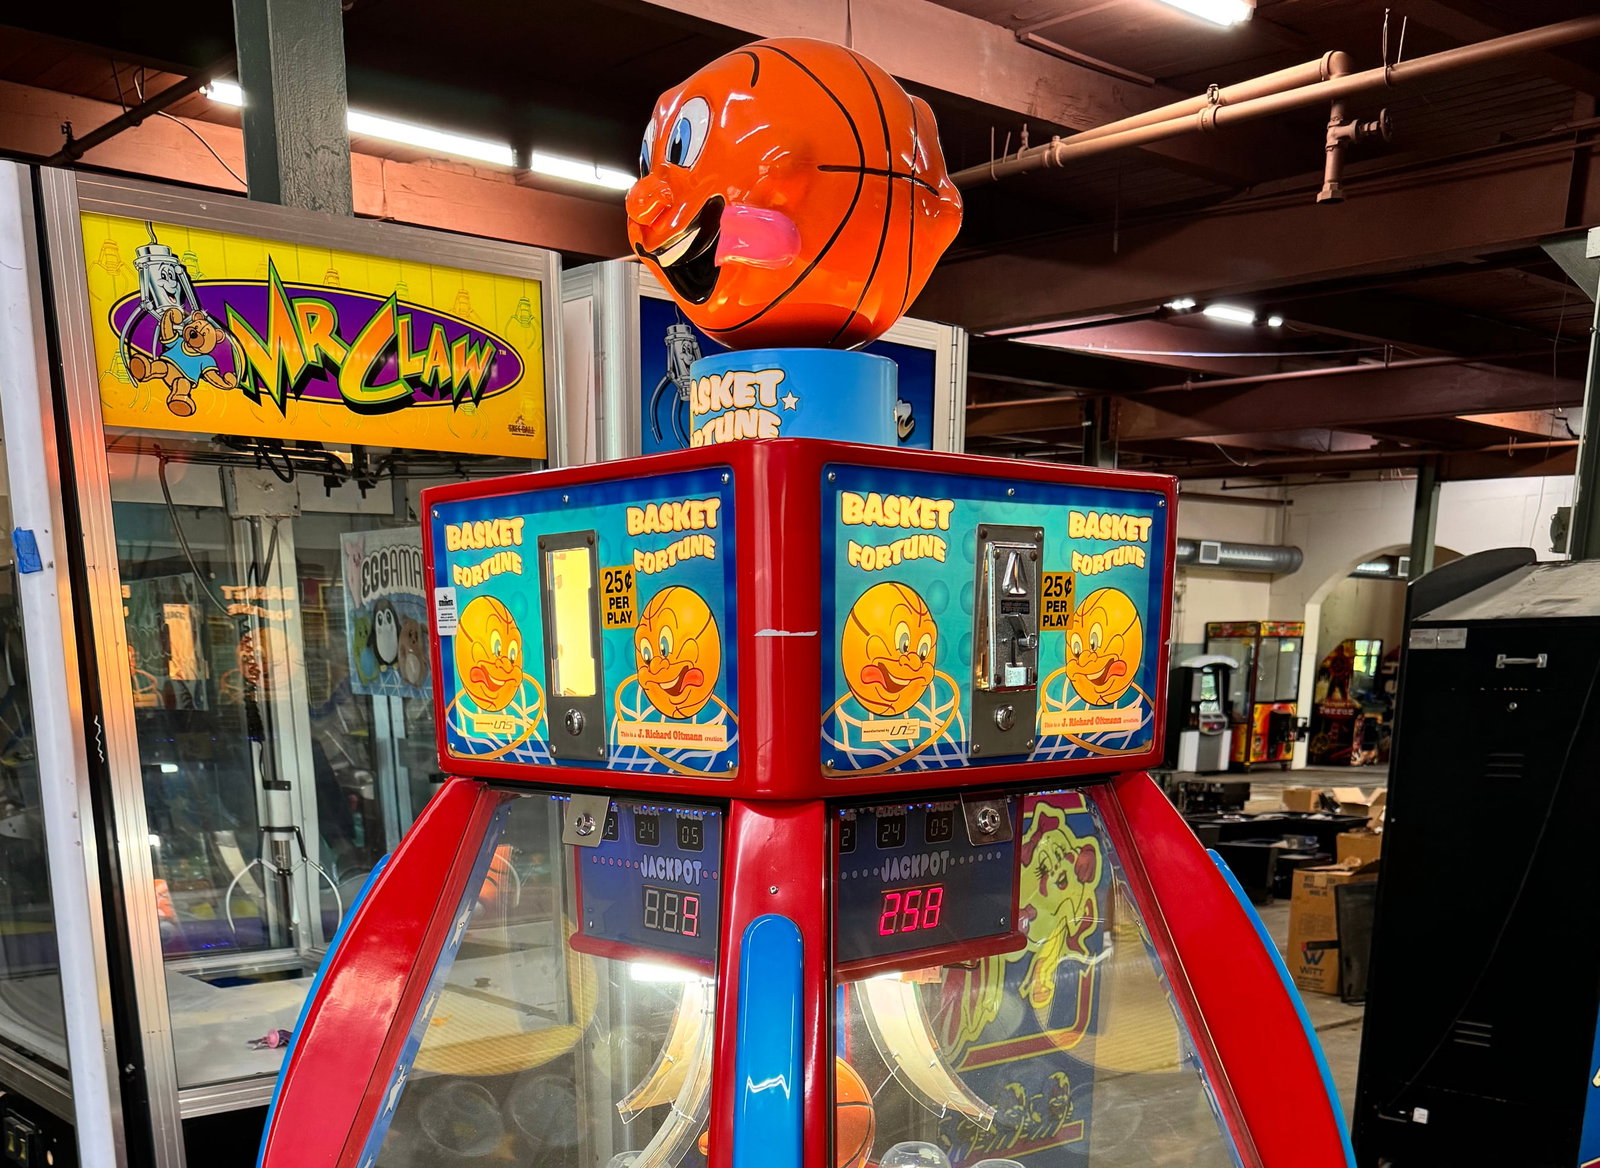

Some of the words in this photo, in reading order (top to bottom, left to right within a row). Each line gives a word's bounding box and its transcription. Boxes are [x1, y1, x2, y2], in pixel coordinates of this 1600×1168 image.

[225, 254, 345, 416] MR
[337, 290, 498, 415] CLAW
[626, 498, 721, 536] BASKET
[841, 491, 955, 530] BASKET
[446, 516, 525, 552] BASKET
[1068, 511, 1152, 542] BASKET
[633, 534, 716, 575] FORTUNE
[848, 534, 947, 571] FORTUNE
[1071, 545, 1146, 576] FORTUNE
[362, 549, 425, 598] EGGAMA
[452, 551, 522, 588] FORTUNE
[604, 570, 633, 594] 25¢
[1043, 575, 1073, 598] 25¢
[607, 610, 632, 625] PLAY
[608, 597, 630, 610] PER
[1046, 601, 1067, 613] PER
[1043, 614, 1069, 627] PLAY
[645, 729, 671, 739] Richard
[639, 821, 655, 840] 24
[681, 826, 699, 845] 05
[881, 823, 901, 843] 24
[930, 818, 949, 837] 05
[640, 854, 702, 886] JACKPOT
[880, 850, 949, 883] JACKPOT
[879, 887, 943, 936] 258
